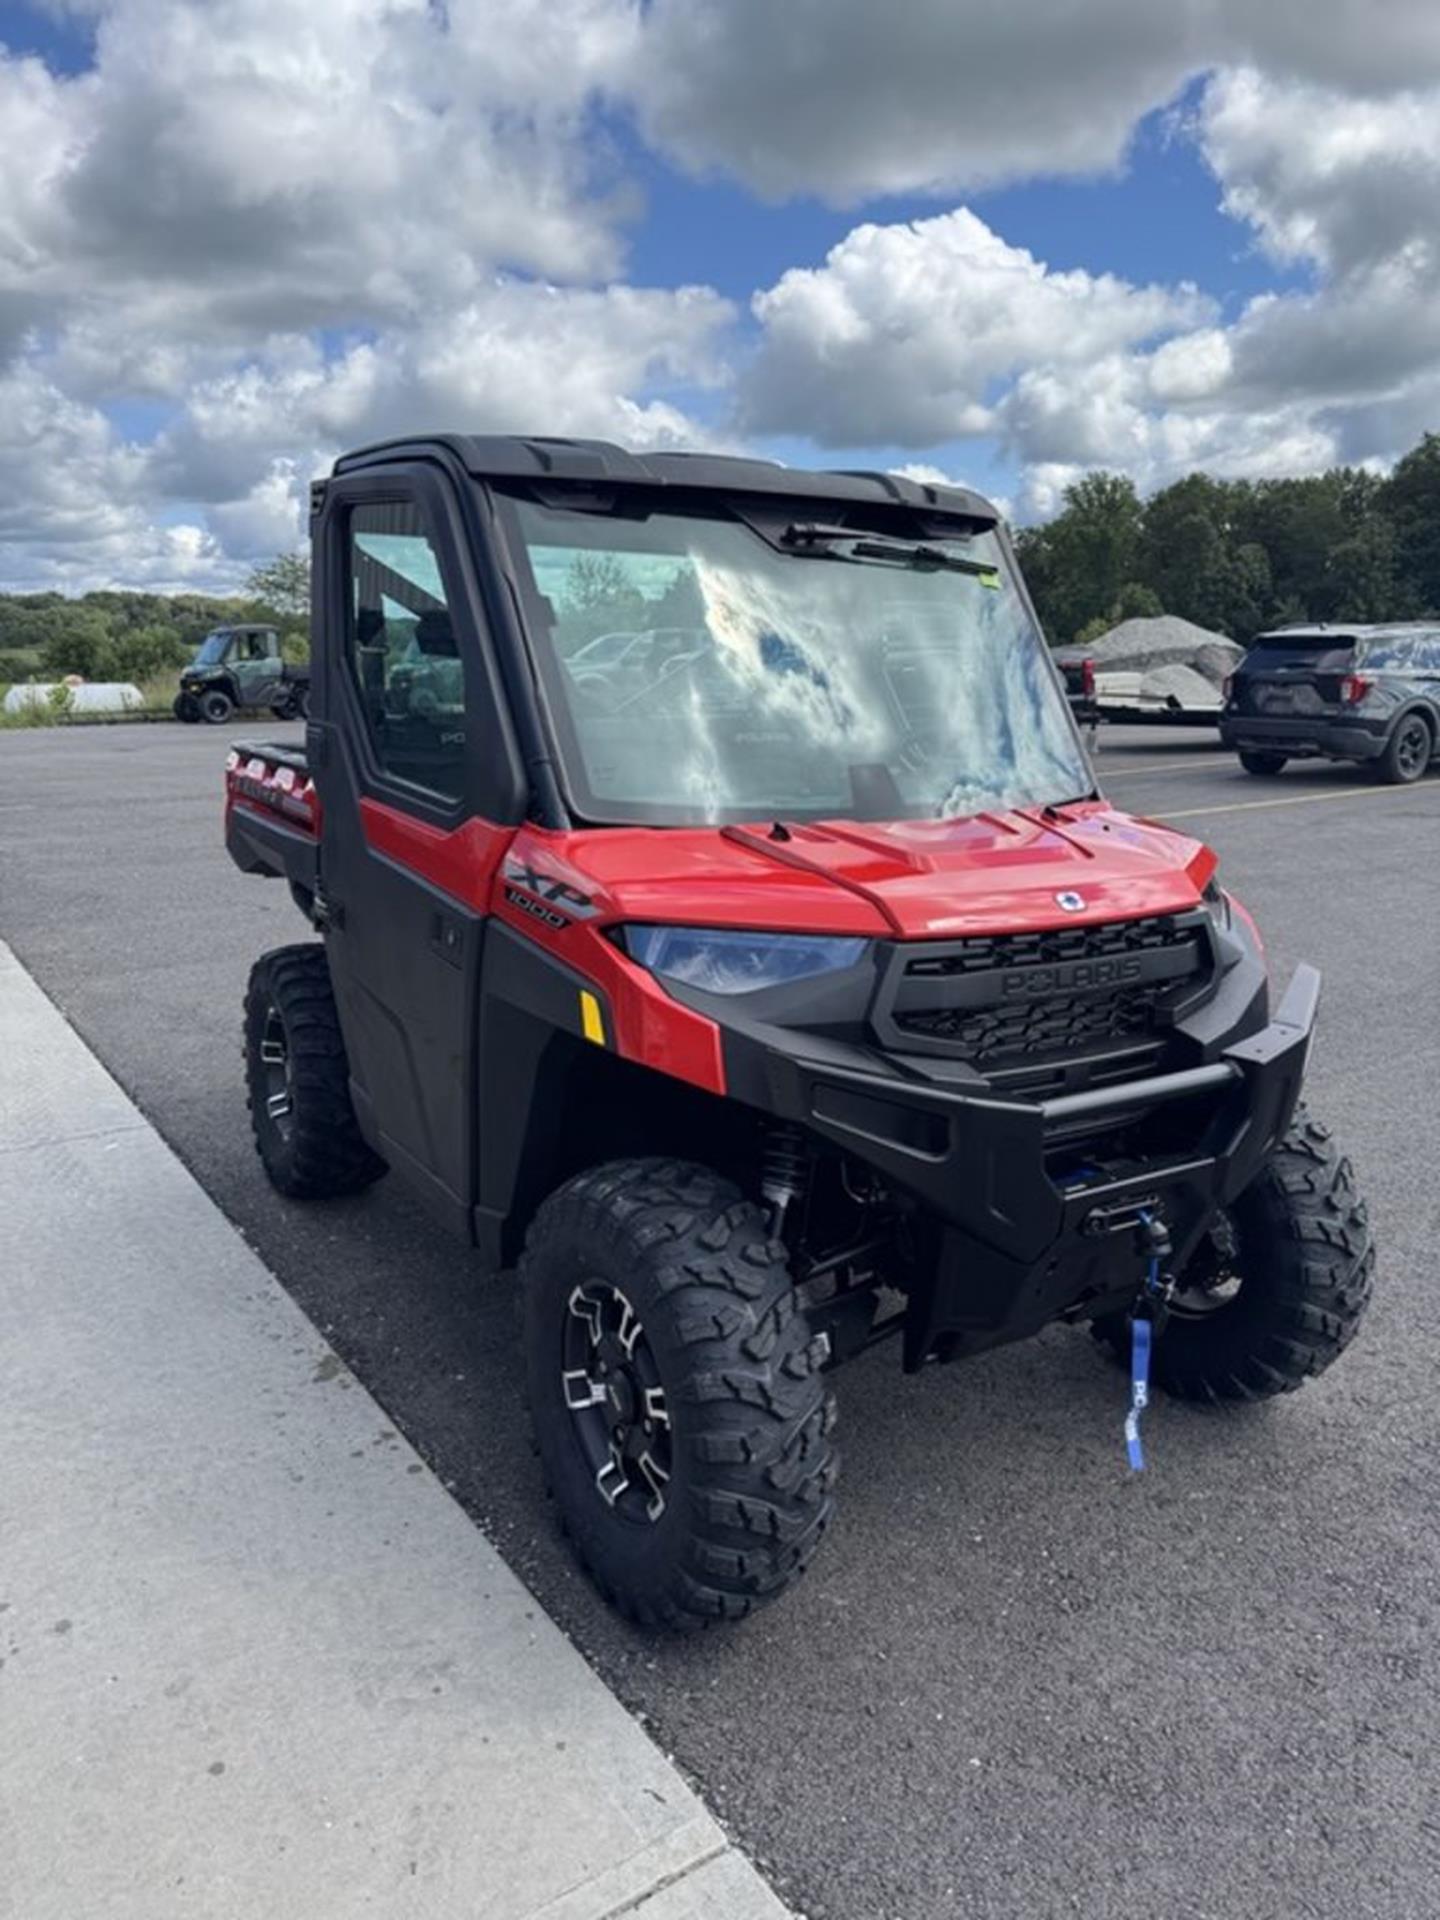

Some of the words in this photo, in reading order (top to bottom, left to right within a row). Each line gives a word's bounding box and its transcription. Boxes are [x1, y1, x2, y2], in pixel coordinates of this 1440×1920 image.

[508, 866, 592, 905] XP
[508, 890, 566, 927] 1000
[1003, 957, 1142, 997] POLARIS
